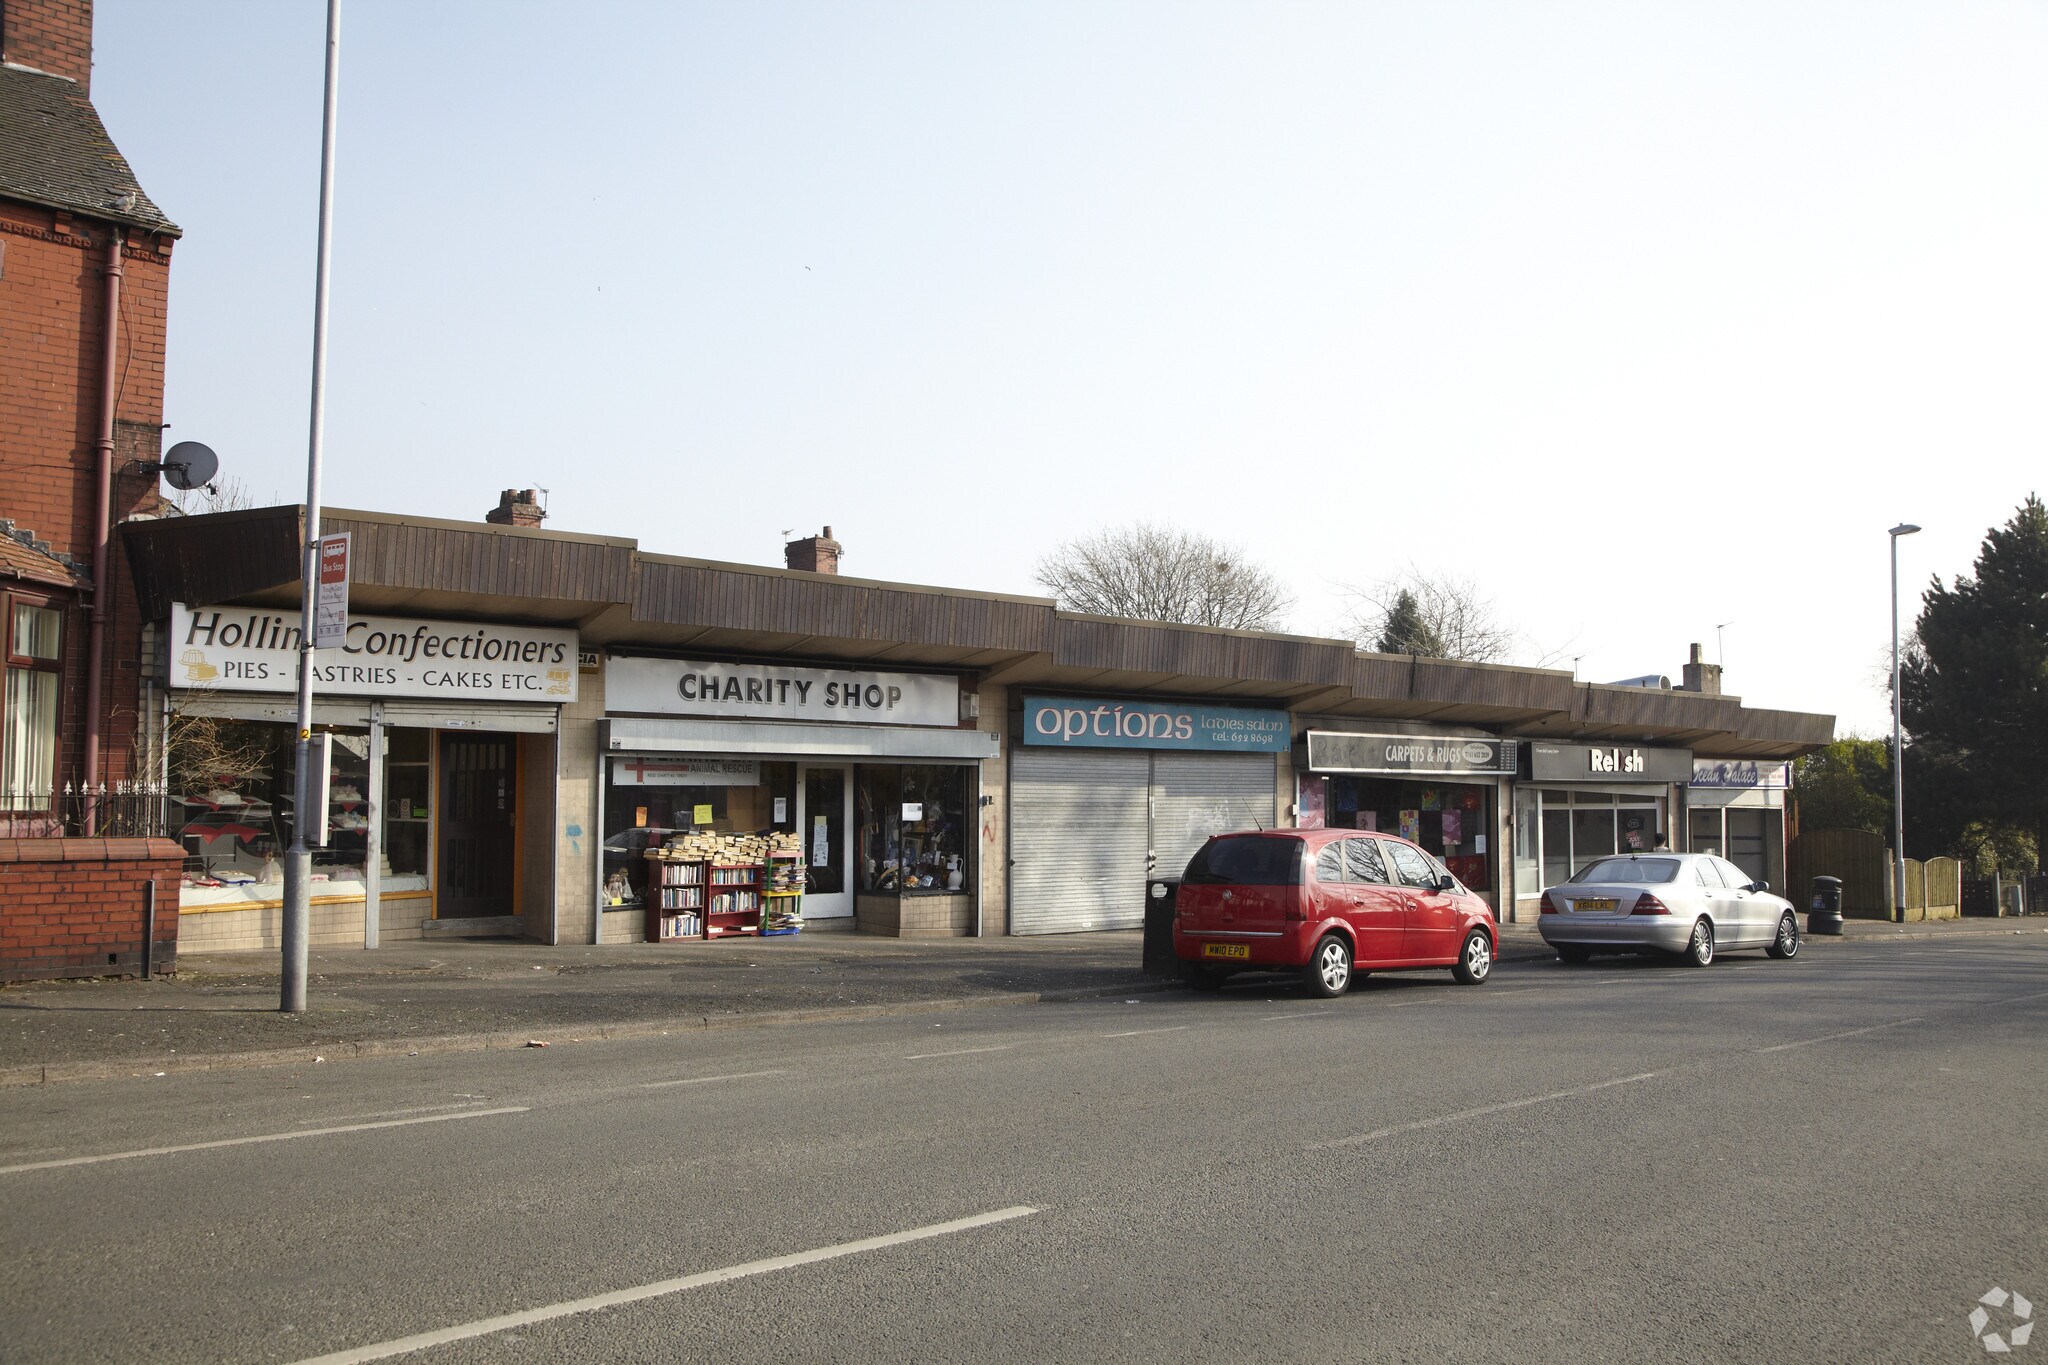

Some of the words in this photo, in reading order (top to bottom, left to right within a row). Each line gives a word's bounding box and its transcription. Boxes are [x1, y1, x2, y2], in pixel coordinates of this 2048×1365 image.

[323, 563, 332, 573] Bus
[333, 562, 344, 574] Stop
[185, 611, 302, 650] Hollin
[342, 621, 567, 664] Confectioners
[224, 661, 269, 680] PIES
[423, 670, 493, 688] CAKES
[502, 674, 543, 691] ETC.
[678, 673, 813, 706] CHARITY
[824, 681, 902, 710] SHOP
[1035, 705, 1194, 742] options
[1201, 714, 1244, 732] ladies
[1246, 719, 1283, 732] salon
[301, 728, 309, 739] 2
[1212, 731, 1230, 742] tel:
[1231, 732, 1249, 743] 652
[1250, 733, 1274, 744] 8698
[1385, 744, 1425, 763] CARPETS
[1427, 747, 1435, 762] &
[1437, 746, 1461, 763] RUGS
[690, 762, 720, 773] ANIMAL
[722, 763, 753, 774] RESCUE
[1208, 945, 1226, 956] MW10
